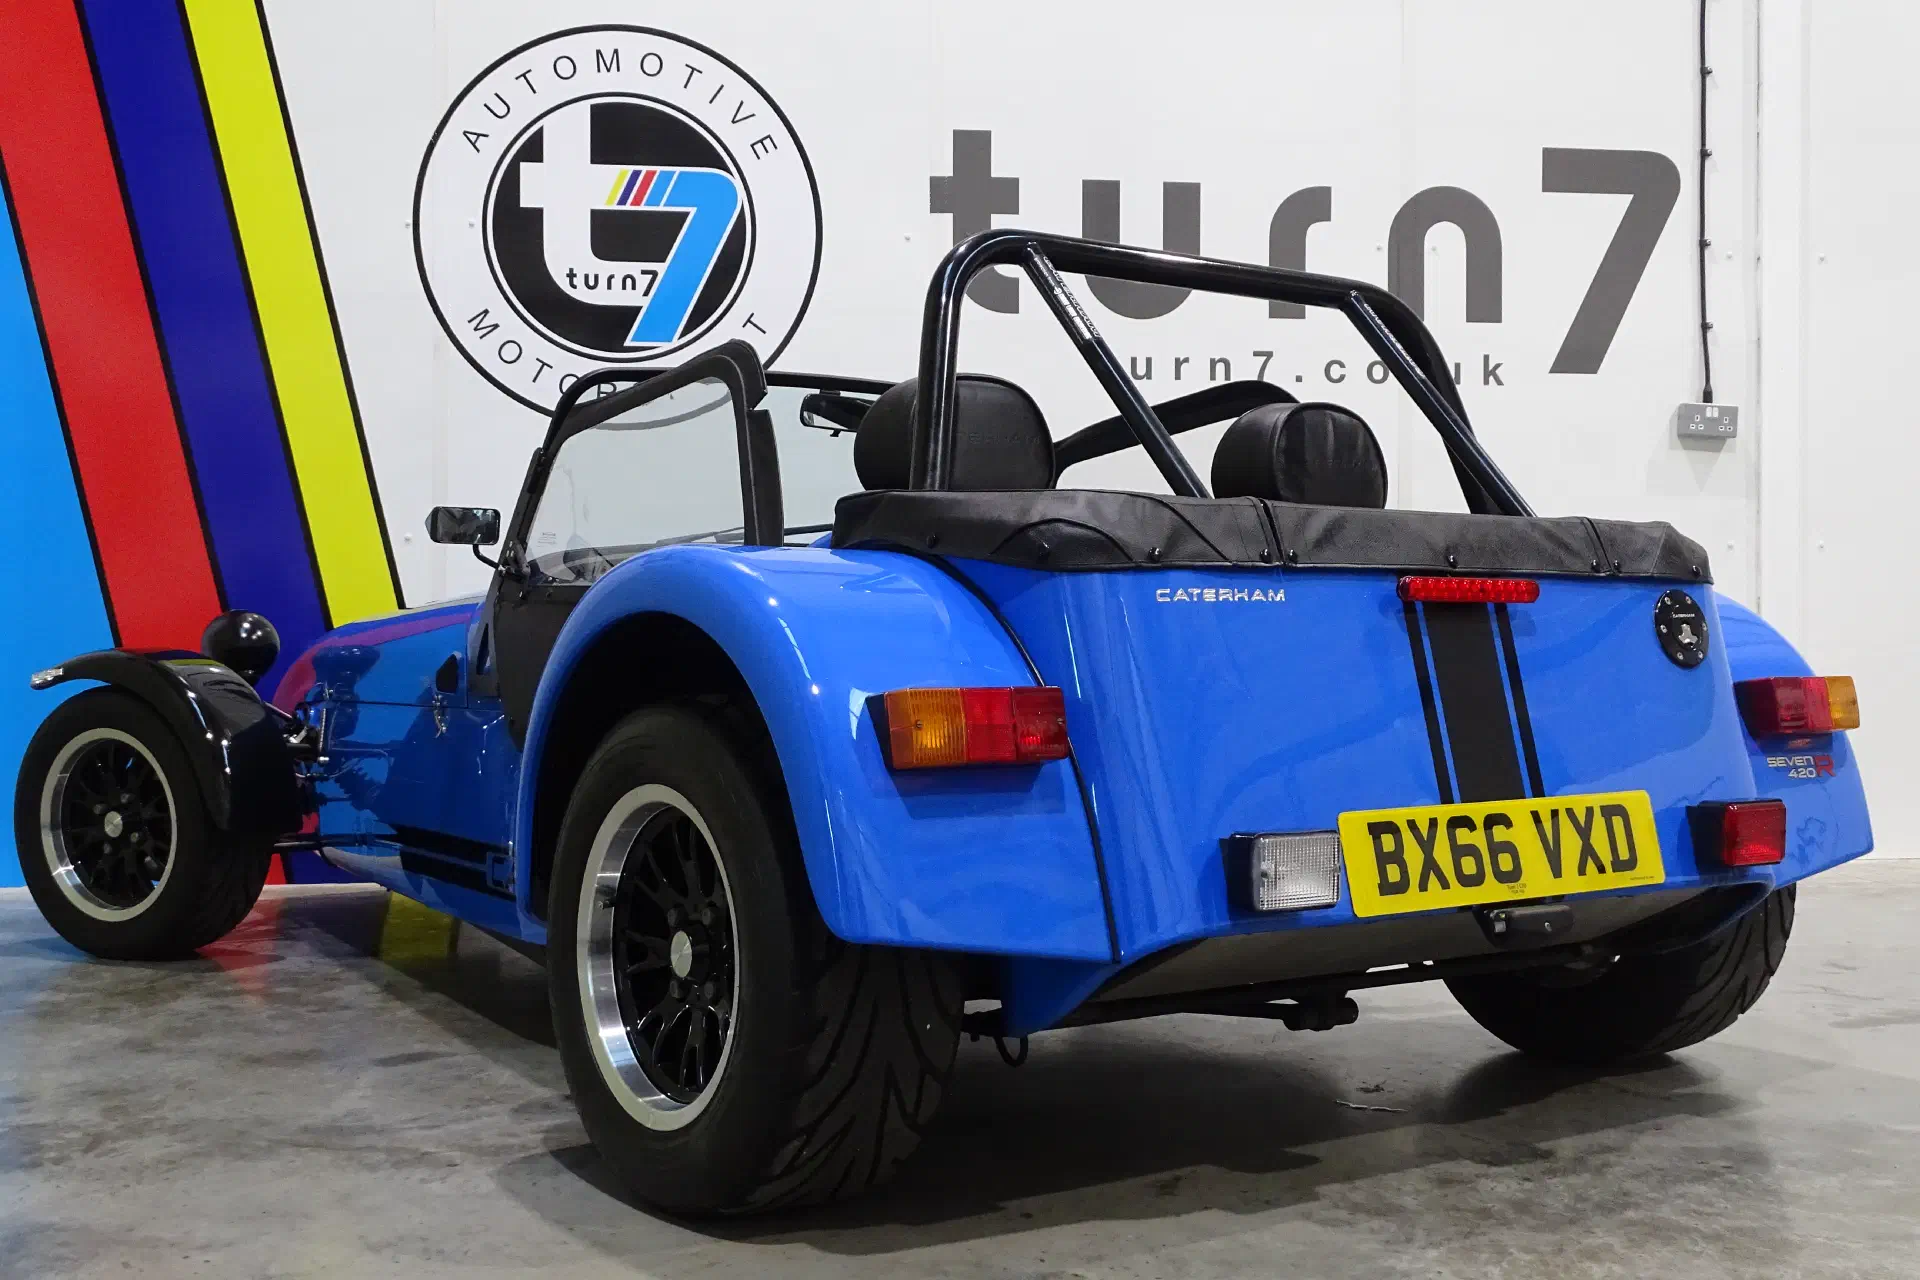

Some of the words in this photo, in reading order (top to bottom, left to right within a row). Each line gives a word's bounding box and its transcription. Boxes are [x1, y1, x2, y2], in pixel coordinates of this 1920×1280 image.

[462, 48, 777, 160] AUTOMOTIVE
[929, 129, 1682, 375] turn7
[566, 267, 659, 297] turn7
[1155, 588, 1286, 602] CATERHAM
[1766, 755, 1814, 767] SEVEN
[1788, 767, 1816, 778] 420
[1367, 812, 1523, 896] BX66
[1530, 804, 1638, 879] VXD
